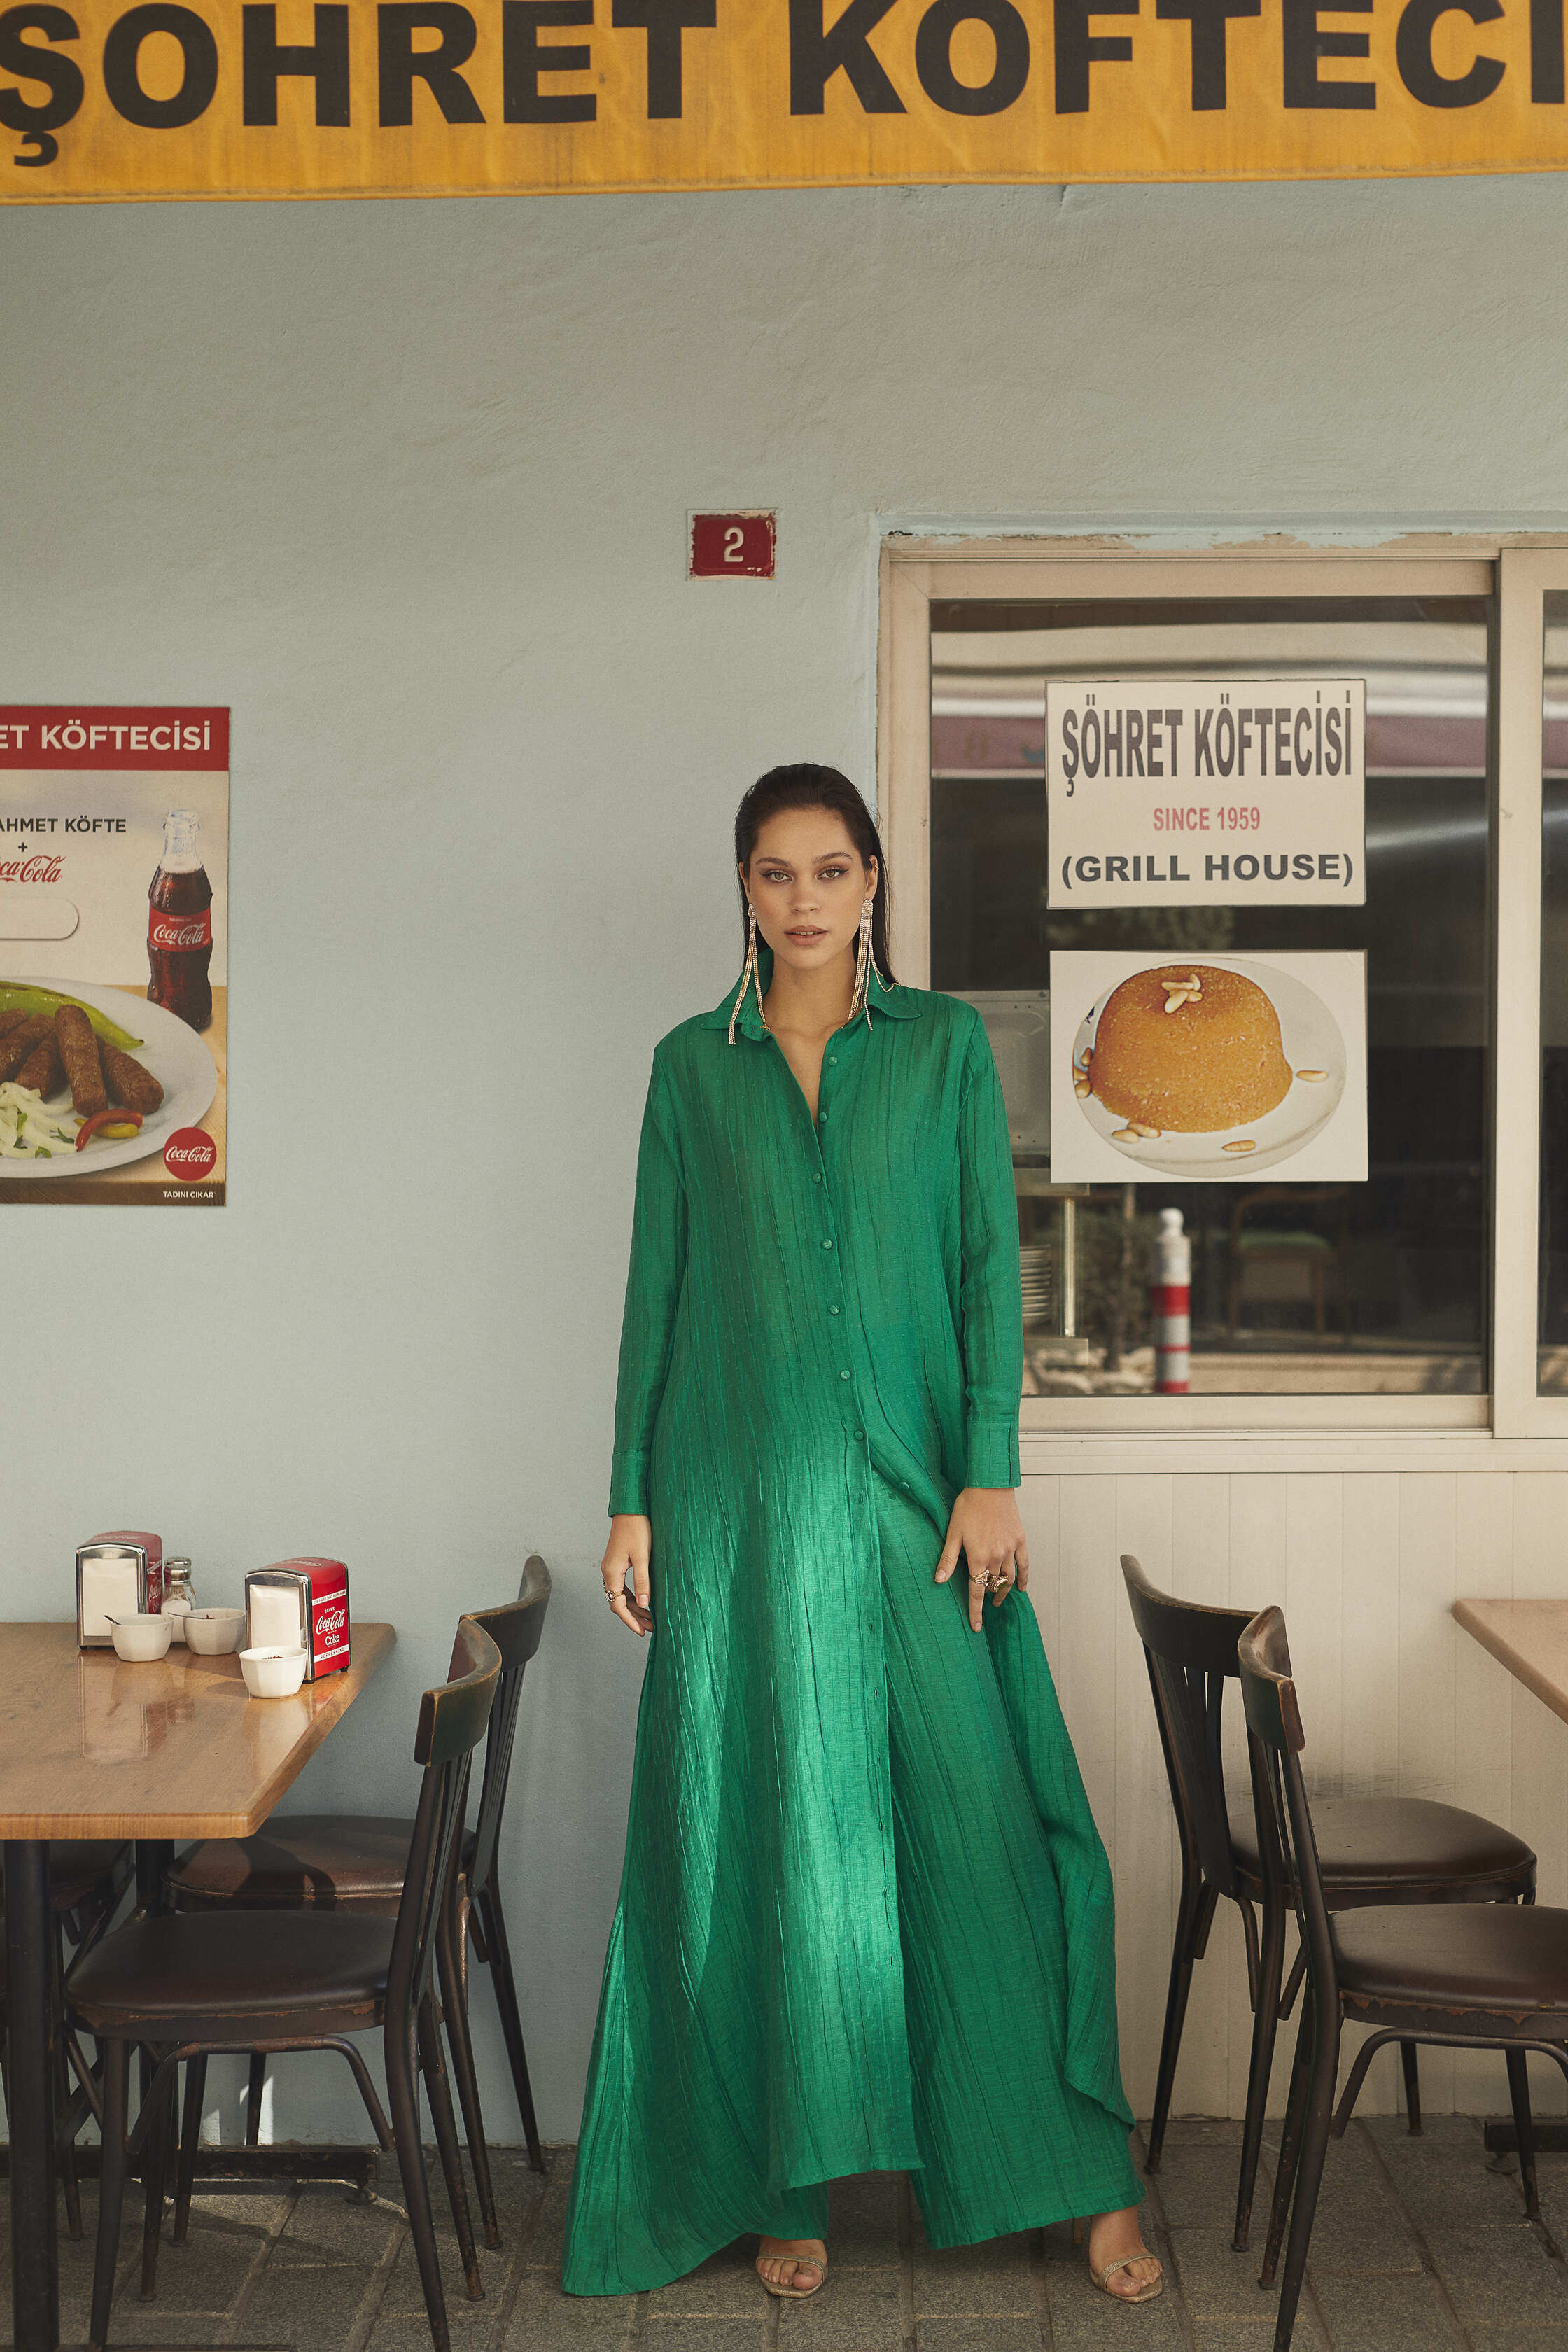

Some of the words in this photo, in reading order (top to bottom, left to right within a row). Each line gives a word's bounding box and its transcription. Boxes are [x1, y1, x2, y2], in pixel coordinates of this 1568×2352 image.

[724, 526, 744, 562] 2
[41, 719, 210, 751] KÖFTECİSİ
[1061, 694, 1183, 797] ŞÖHRET
[1194, 690, 1352, 777] KÖFTECİSİ
[65, 815, 127, 833] KÖFTE
[1153, 807, 1210, 831] SINCE
[1217, 806, 1261, 830] 1959
[1062, 855, 1191, 890] (GRILL
[1205, 854, 1353, 888] HOUSE)
[153, 923, 206, 945] Coca-Cola
[165, 1145, 213, 1163] Coca-Cola
[190, 1191, 214, 1199] ÇIKAR
[316, 1609, 345, 1635] Coca-Cola
[325, 1633, 340, 1646] Coke
